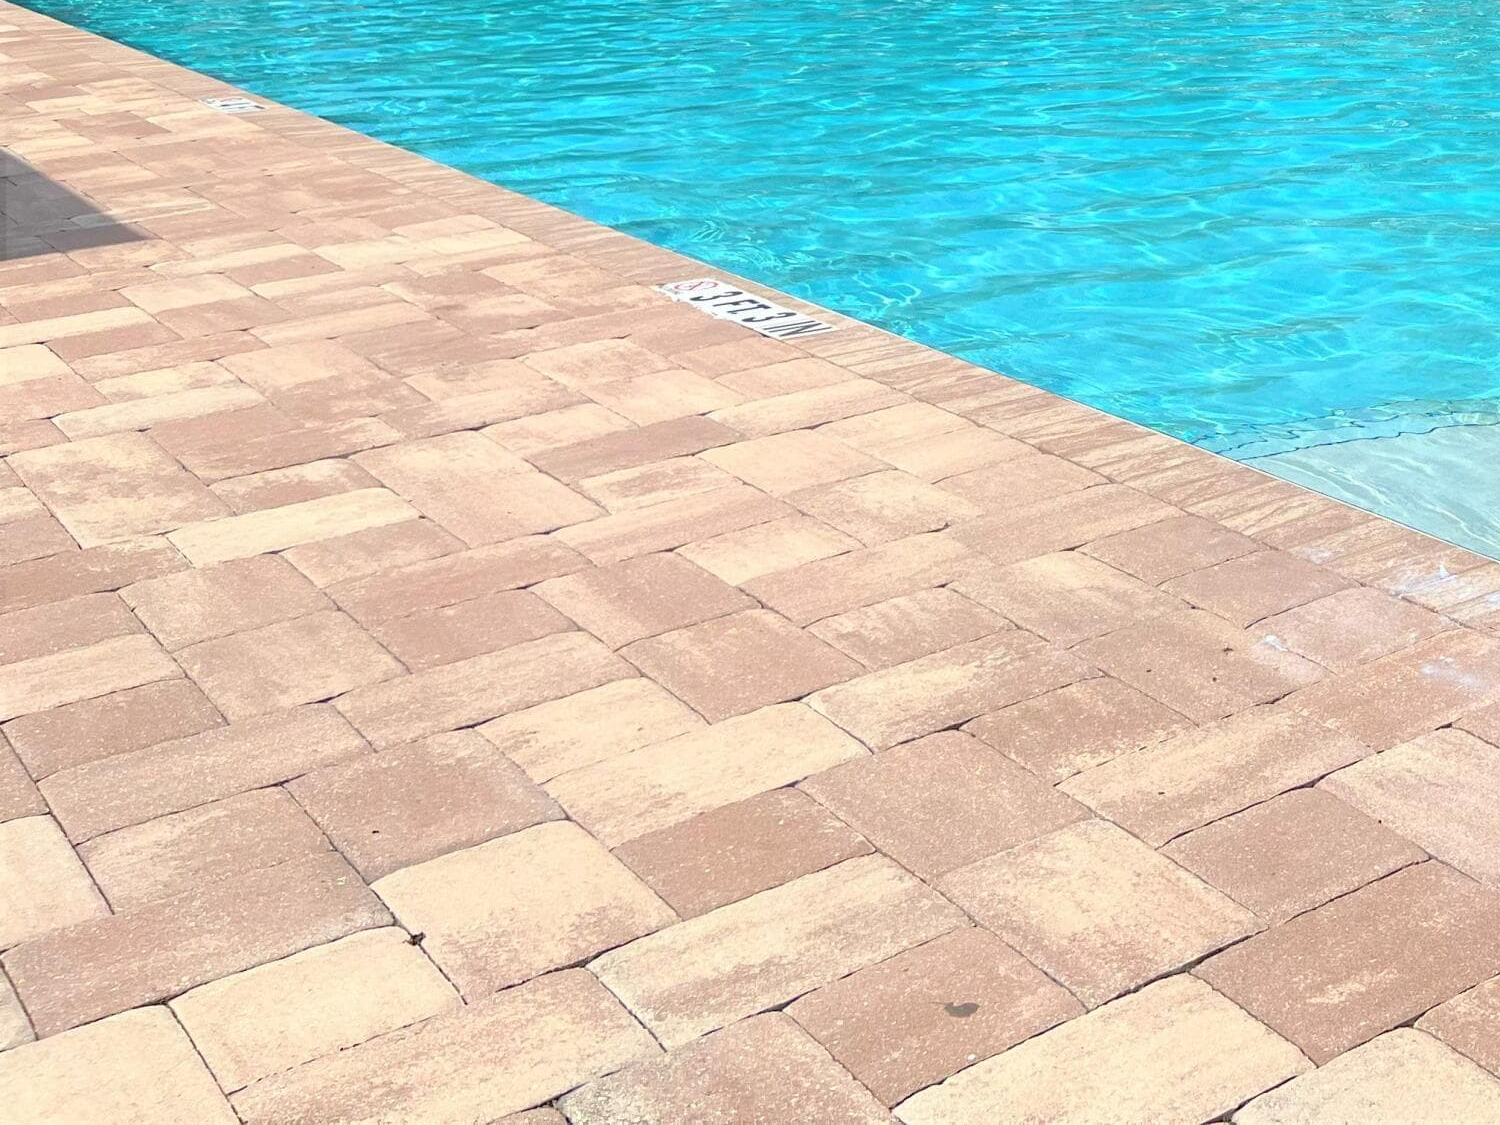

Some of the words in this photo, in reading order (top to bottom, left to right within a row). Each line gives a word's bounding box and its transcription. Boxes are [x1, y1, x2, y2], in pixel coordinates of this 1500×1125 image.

[689, 291, 743, 302] 3
[712, 299, 772, 314] FT
[741, 312, 798, 323] 3
[762, 320, 833, 338] IN
